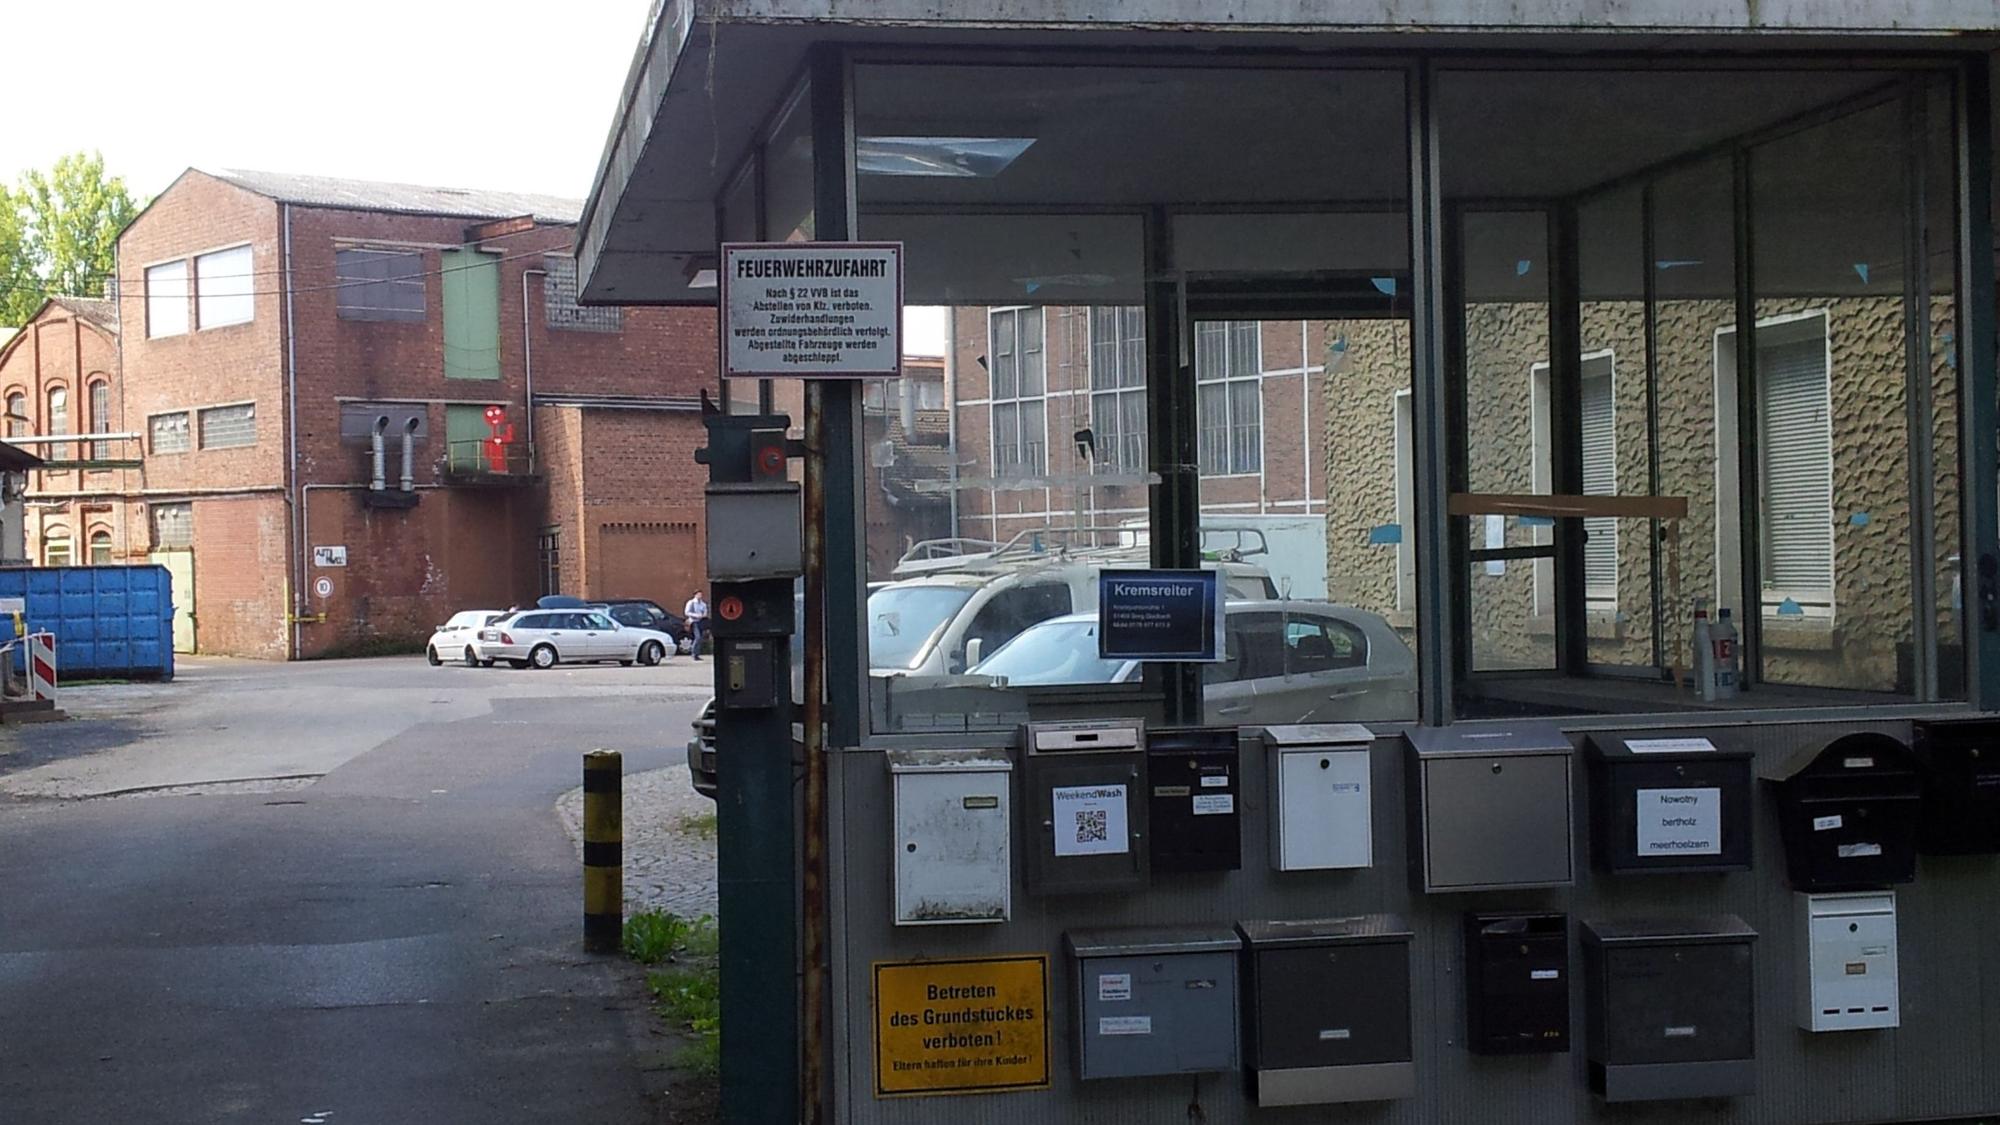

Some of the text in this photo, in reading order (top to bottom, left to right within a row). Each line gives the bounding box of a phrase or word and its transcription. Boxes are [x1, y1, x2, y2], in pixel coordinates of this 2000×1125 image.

[737, 259, 887, 278] FEUERWEHRZUFAHRT
[766, 287, 787, 298] Nach
[797, 287, 808, 298] 22
[810, 287, 828, 298] VVB
[831, 287, 841, 298] ist
[843, 287, 859, 298] das
[753, 301, 794, 311] Abstellen
[795, 303, 811, 311] von
[832, 301, 873, 311] verboten.
[770, 314, 855, 325] Zuwiderhandlungen
[734, 326, 891, 339] werden ordnungsbehördlich verfolgt.
[748, 339, 877, 351] Abgestellte Fahrzeuge werden
[782, 352, 843, 364] abgeschleppt.
[320, 582, 328, 592] 10
[1114, 583, 1194, 597] Kremsreiter
[1056, 788, 1122, 800] WeekendWash
[1660, 795, 1698, 805] Nowotny
[1662, 817, 1697, 827] bertholz
[927, 984, 996, 1000] Betreten
[890, 1006, 1034, 1027] des Grundstückes
[893, 1061, 922, 1071] Eltern
[924, 1059, 956, 1069] haften
[958, 1057, 970, 1067] für
